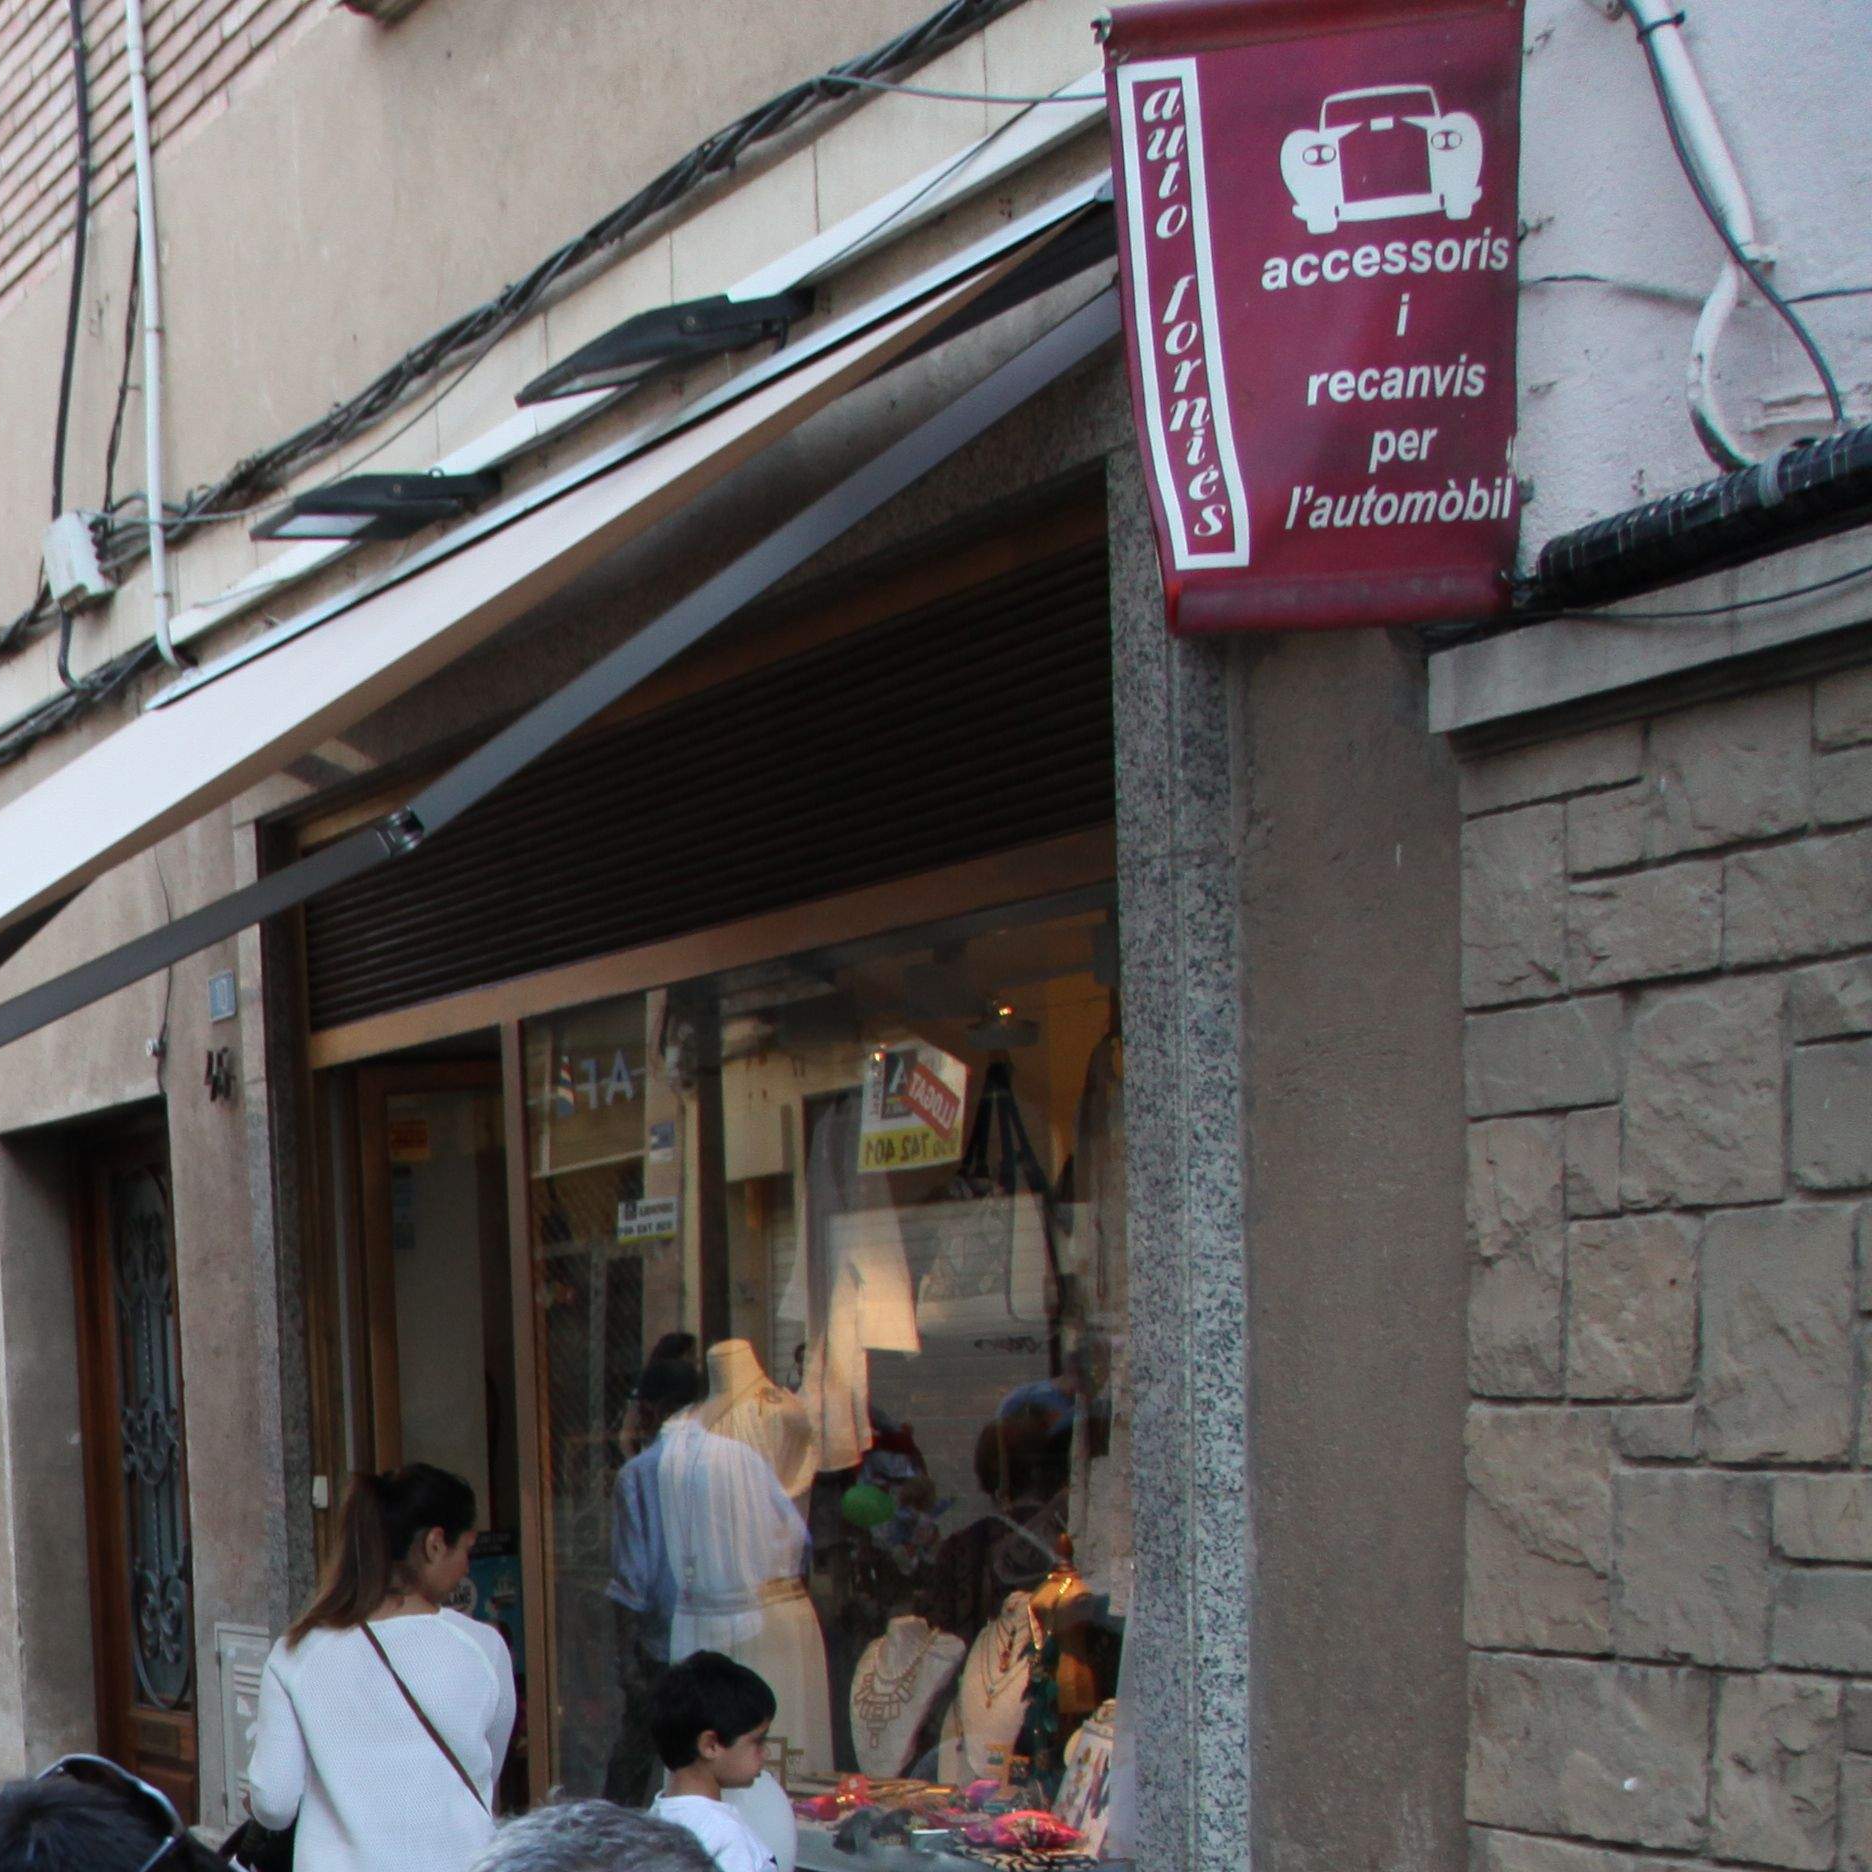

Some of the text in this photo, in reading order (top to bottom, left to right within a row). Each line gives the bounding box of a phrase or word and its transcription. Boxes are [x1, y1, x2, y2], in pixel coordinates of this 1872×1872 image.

[1260, 225, 1511, 292] accessoris
[1142, 81, 1228, 539] auto fornies
[1395, 294, 1410, 337] i
[1305, 354, 1487, 406] recanvis
[1368, 424, 1439, 474] per
[1285, 477, 1514, 531] l'automòbil
